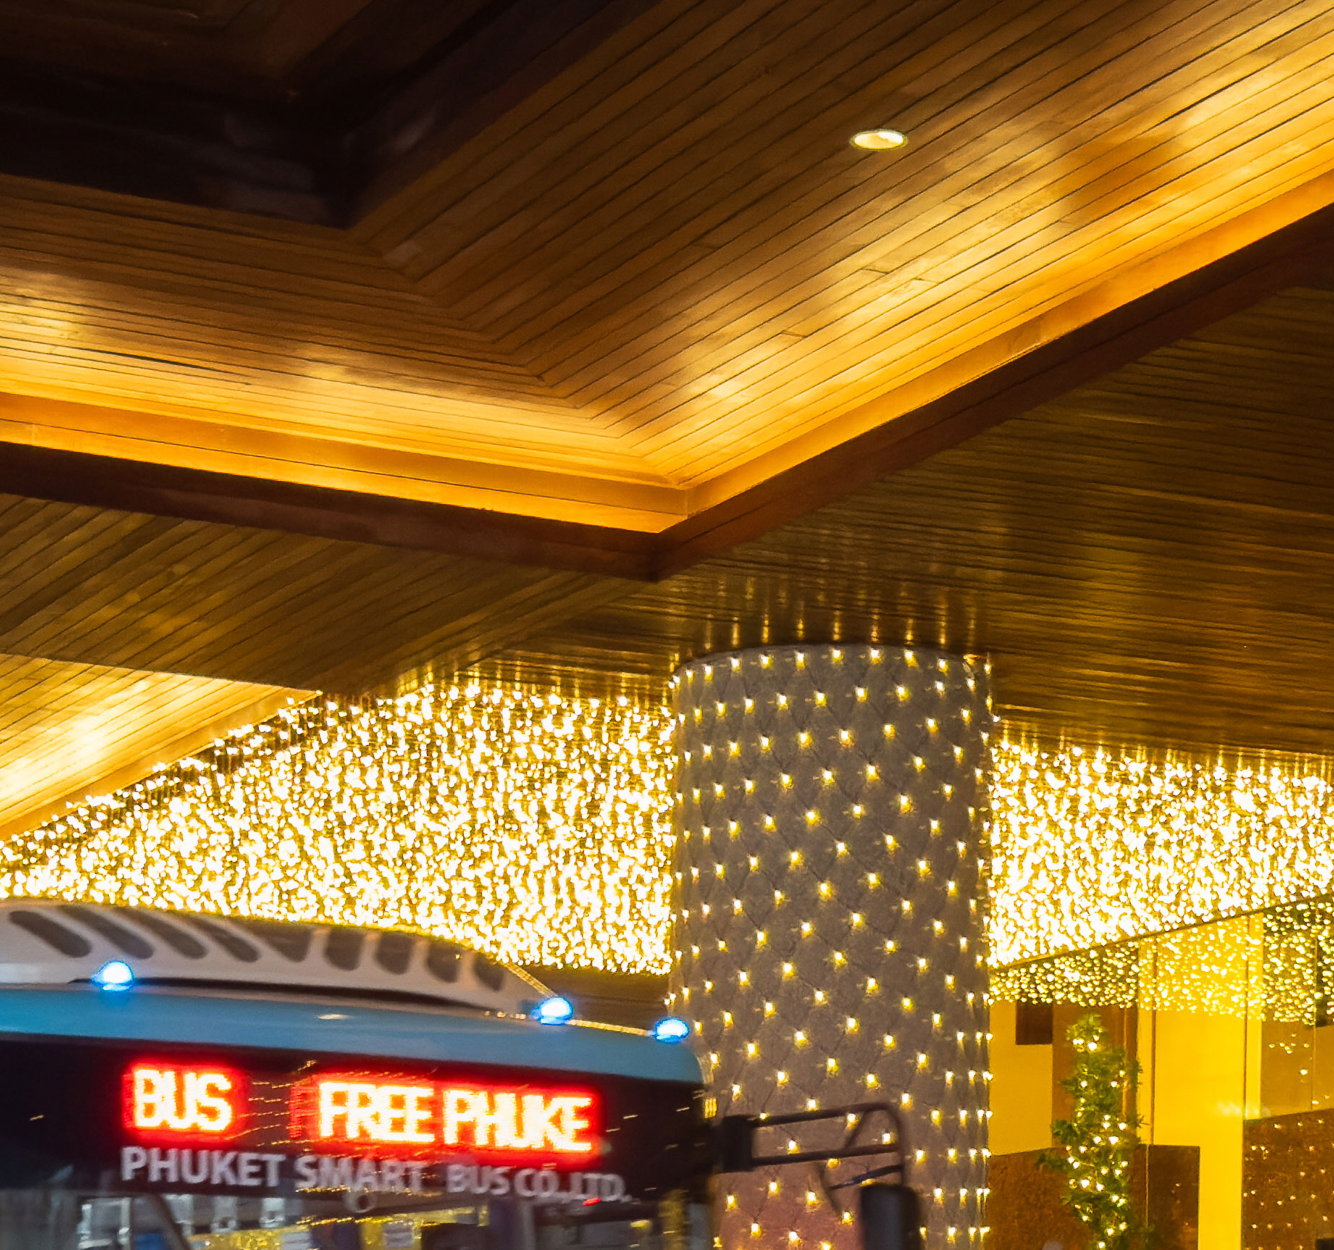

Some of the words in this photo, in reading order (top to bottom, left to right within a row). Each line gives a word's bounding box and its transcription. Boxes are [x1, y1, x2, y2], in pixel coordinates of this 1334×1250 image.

[133, 1069, 233, 1132] BUS
[319, 1081, 435, 1143] FREE
[443, 1089, 592, 1153] PHUKE
[121, 1146, 286, 1188] PHUKET
[293, 1153, 423, 1198] SMART
[446, 1163, 511, 1196] BUS
